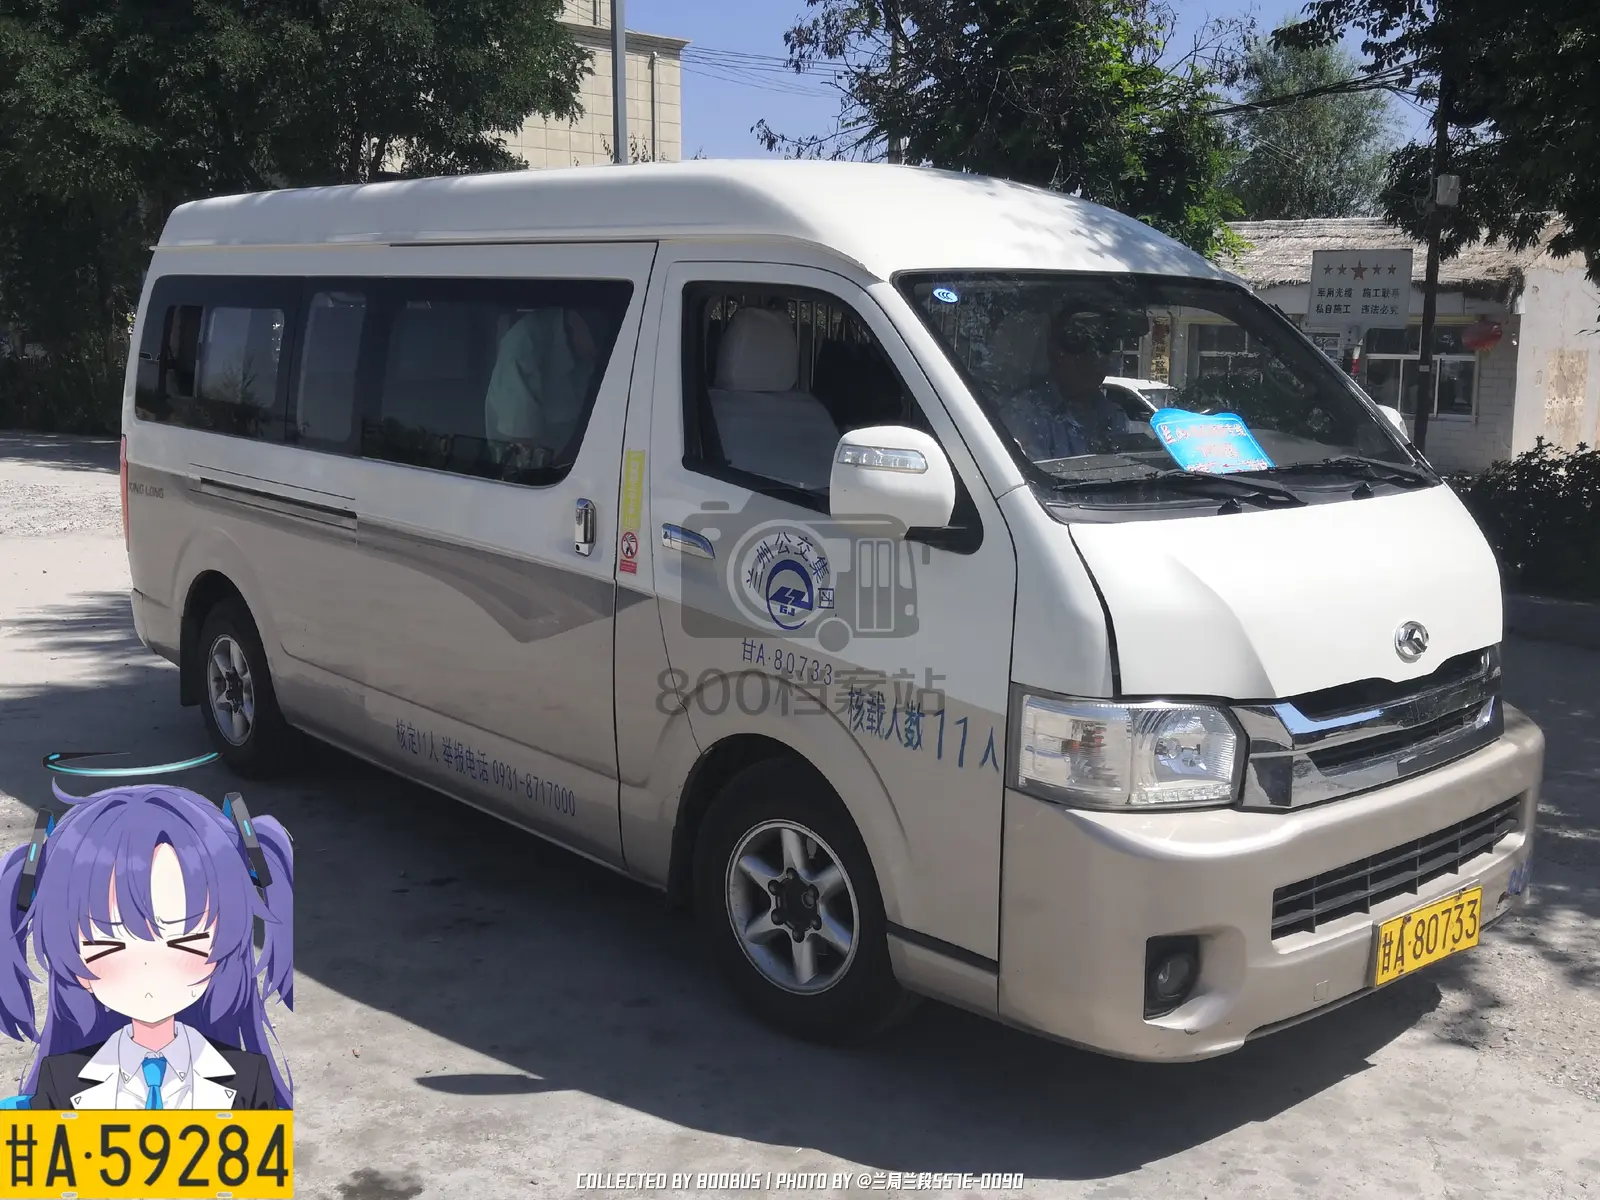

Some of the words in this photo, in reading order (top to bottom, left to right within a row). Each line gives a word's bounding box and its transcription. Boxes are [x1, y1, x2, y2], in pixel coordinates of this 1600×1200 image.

[1316, 303, 1351, 315] 私自施工
[129, 482, 145, 495] KING
[145, 485, 164, 499] LONG
[746, 531, 835, 610] 兰州公交集团
[442, 736, 489, 784] 举报电话
[493, 760, 576, 817] 0931-8717000
